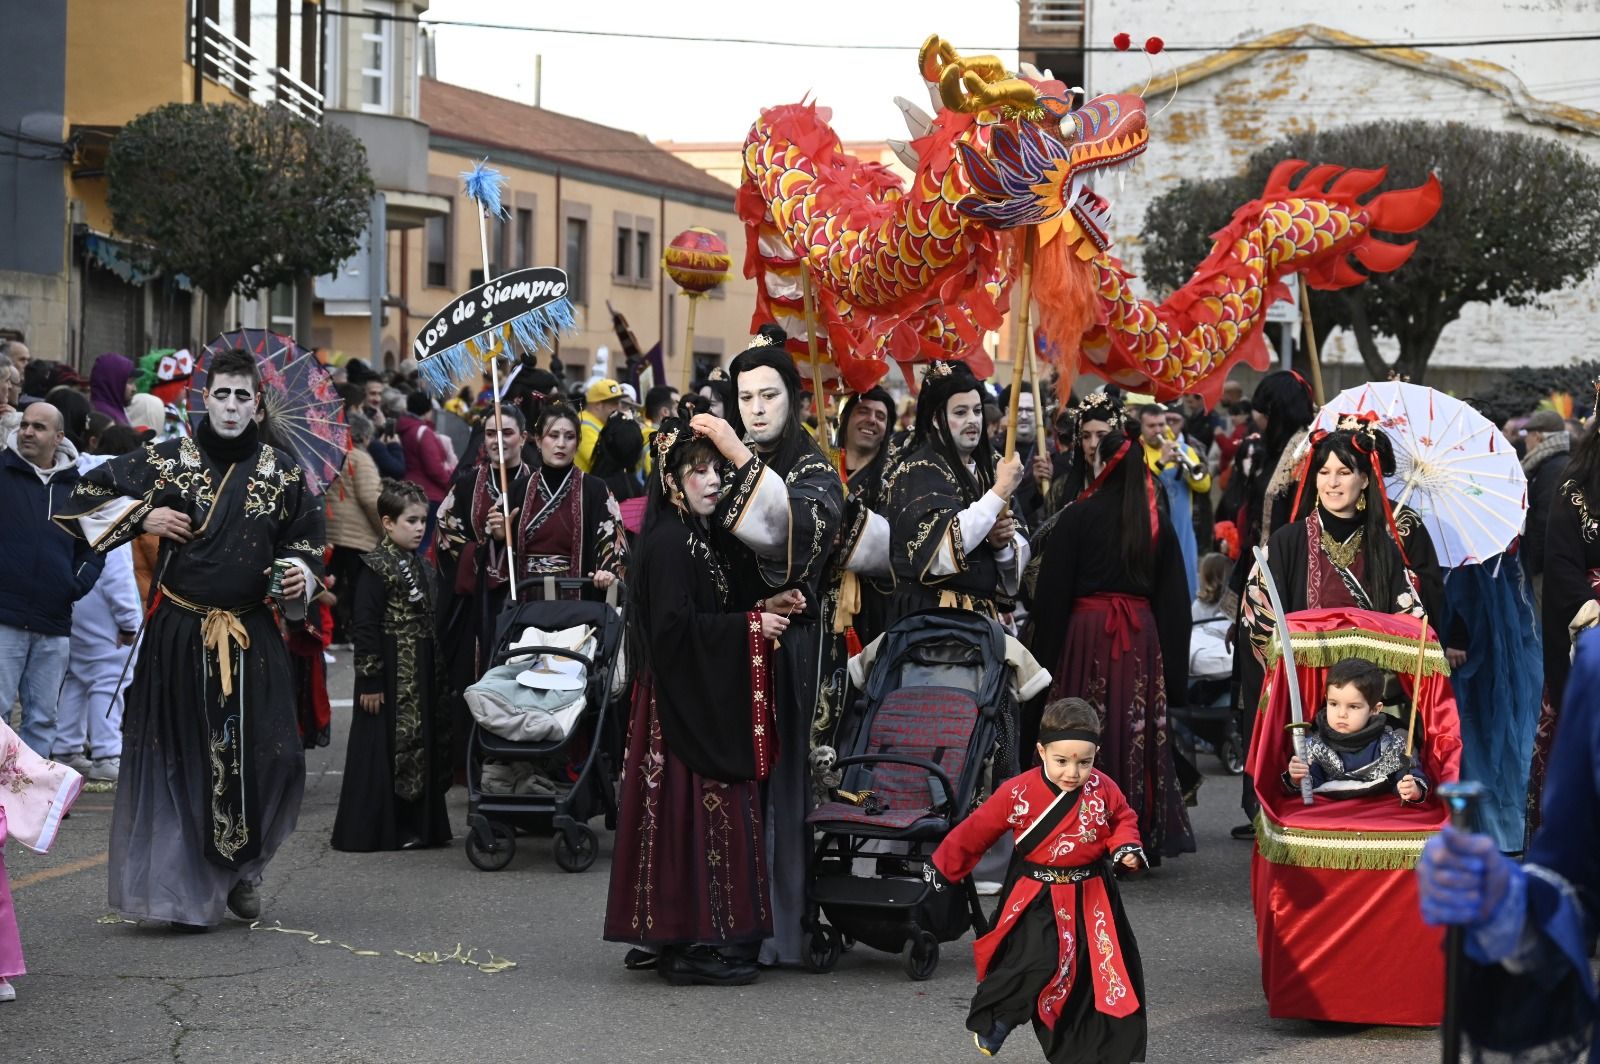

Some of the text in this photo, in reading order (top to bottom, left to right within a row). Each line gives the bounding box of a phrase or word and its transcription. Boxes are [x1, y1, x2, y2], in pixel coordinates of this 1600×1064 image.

[414, 280, 566, 358] Los de Siempre
